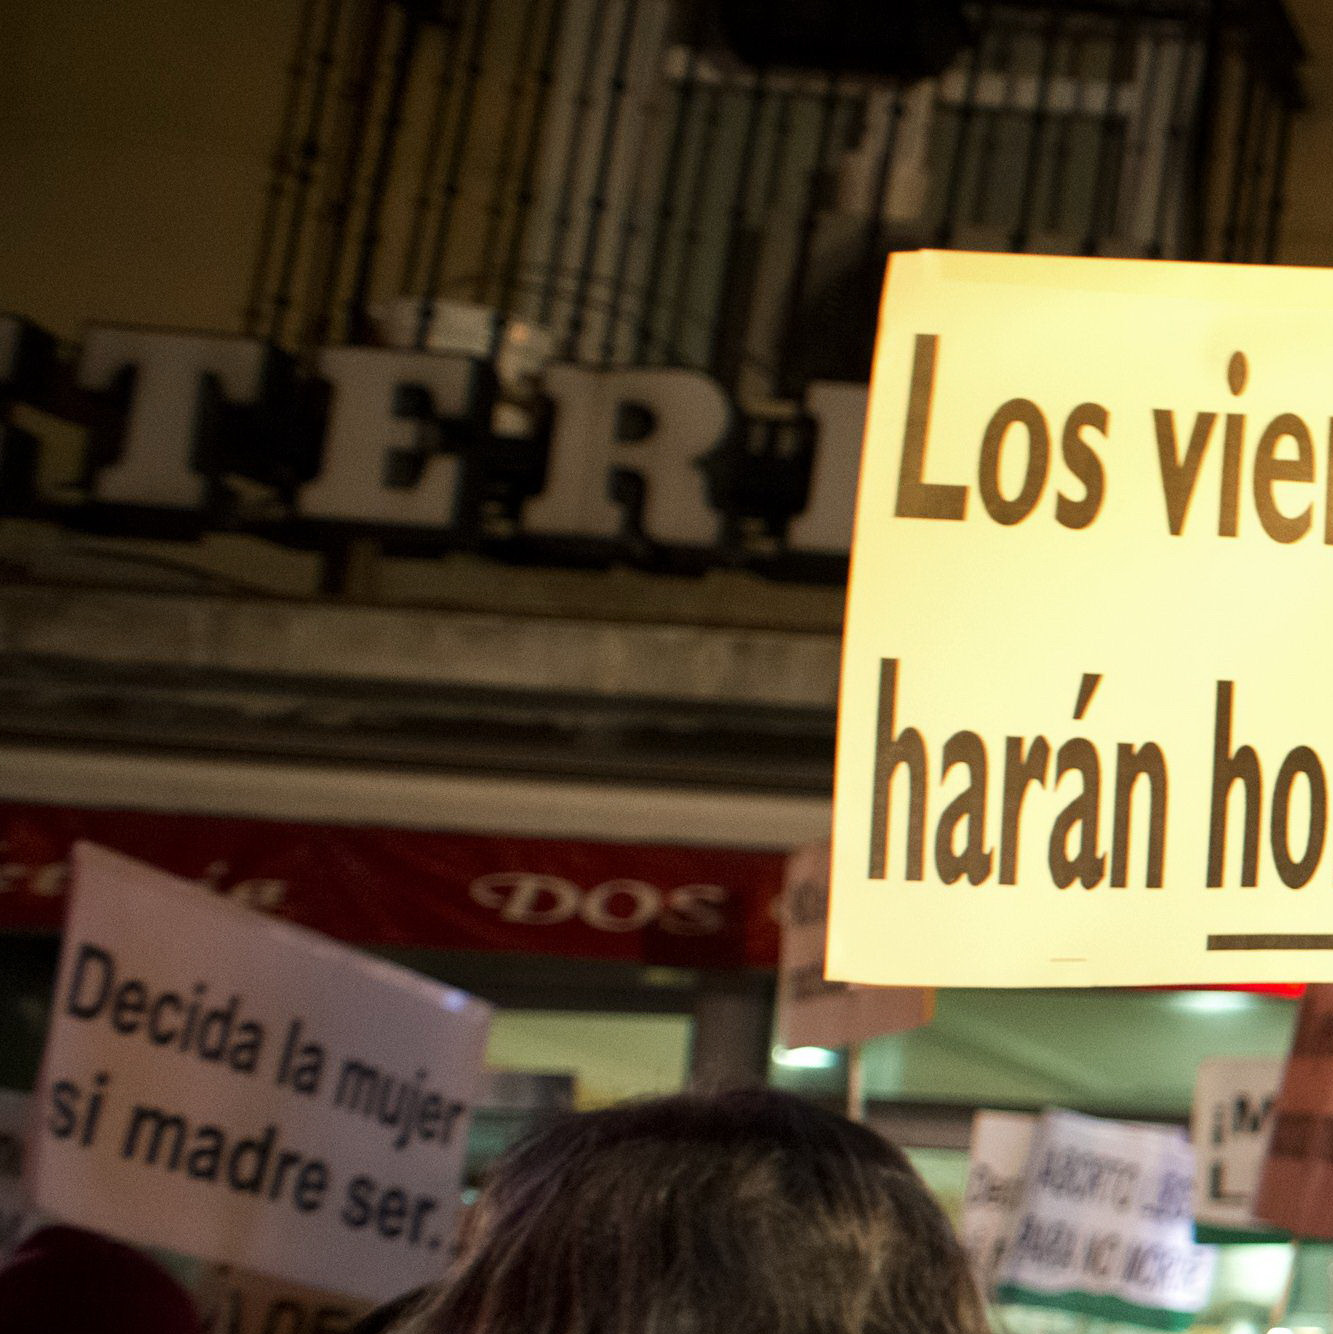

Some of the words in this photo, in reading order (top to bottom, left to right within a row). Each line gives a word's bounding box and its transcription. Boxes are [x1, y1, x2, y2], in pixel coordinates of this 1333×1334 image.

[893, 333, 1109, 530] Los
[867, 657, 1169, 891] harán
[66, 942, 266, 1074] Decida
[276, 1018, 327, 1096] la
[334, 1059, 467, 1151] mujer
[50, 1071, 110, 1148] si
[121, 1104, 331, 1214] madre
[342, 1173, 442, 1250] ser.
